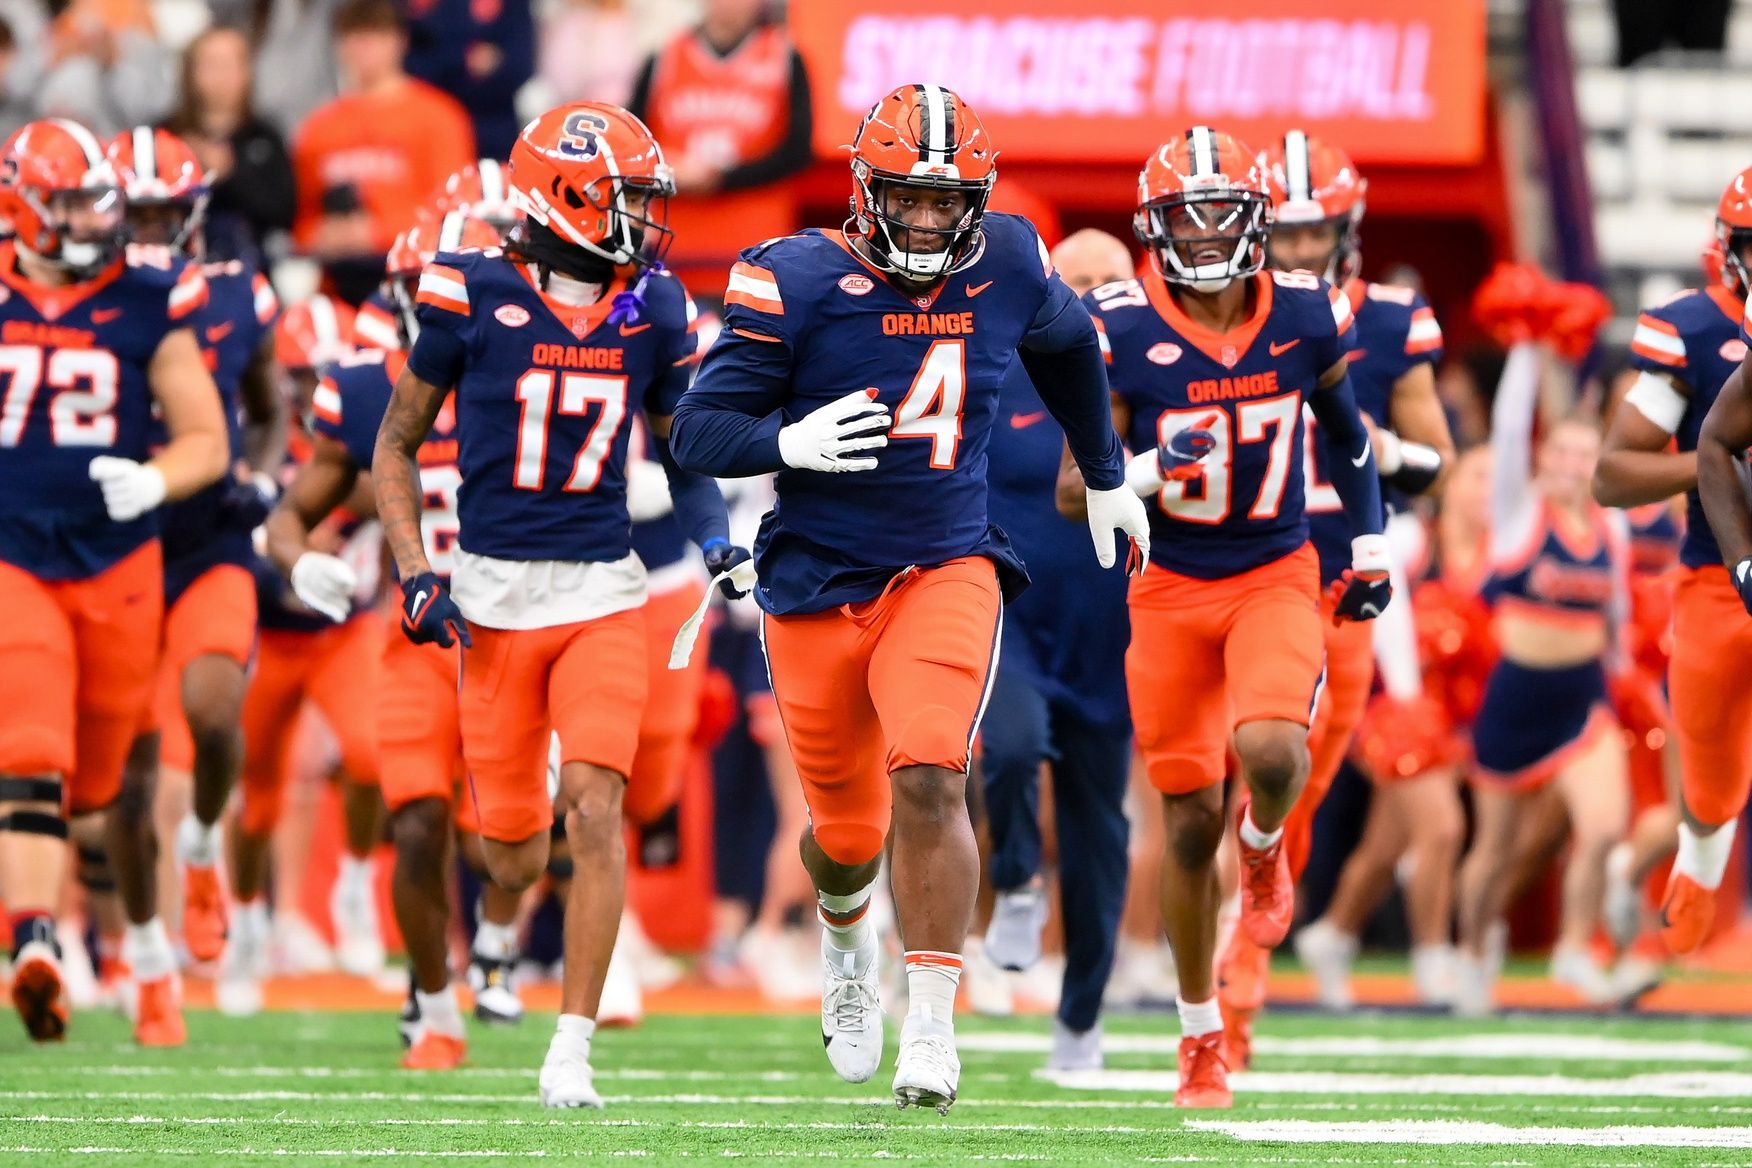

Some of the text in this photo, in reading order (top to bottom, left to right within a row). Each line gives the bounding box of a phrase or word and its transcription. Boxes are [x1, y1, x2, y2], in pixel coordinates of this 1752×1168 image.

[838, 14, 1153, 116] SYRACUSE
[1151, 16, 1432, 119] FOOTBALL
[558, 109, 610, 162] S
[845, 279, 869, 287] ACC
[881, 311, 975, 336] ORANGE
[532, 343, 624, 369] ORANGE
[0, 345, 119, 448] 72
[888, 338, 966, 470] 4
[1186, 370, 1279, 404] ORANGE
[512, 367, 629, 493] 17
